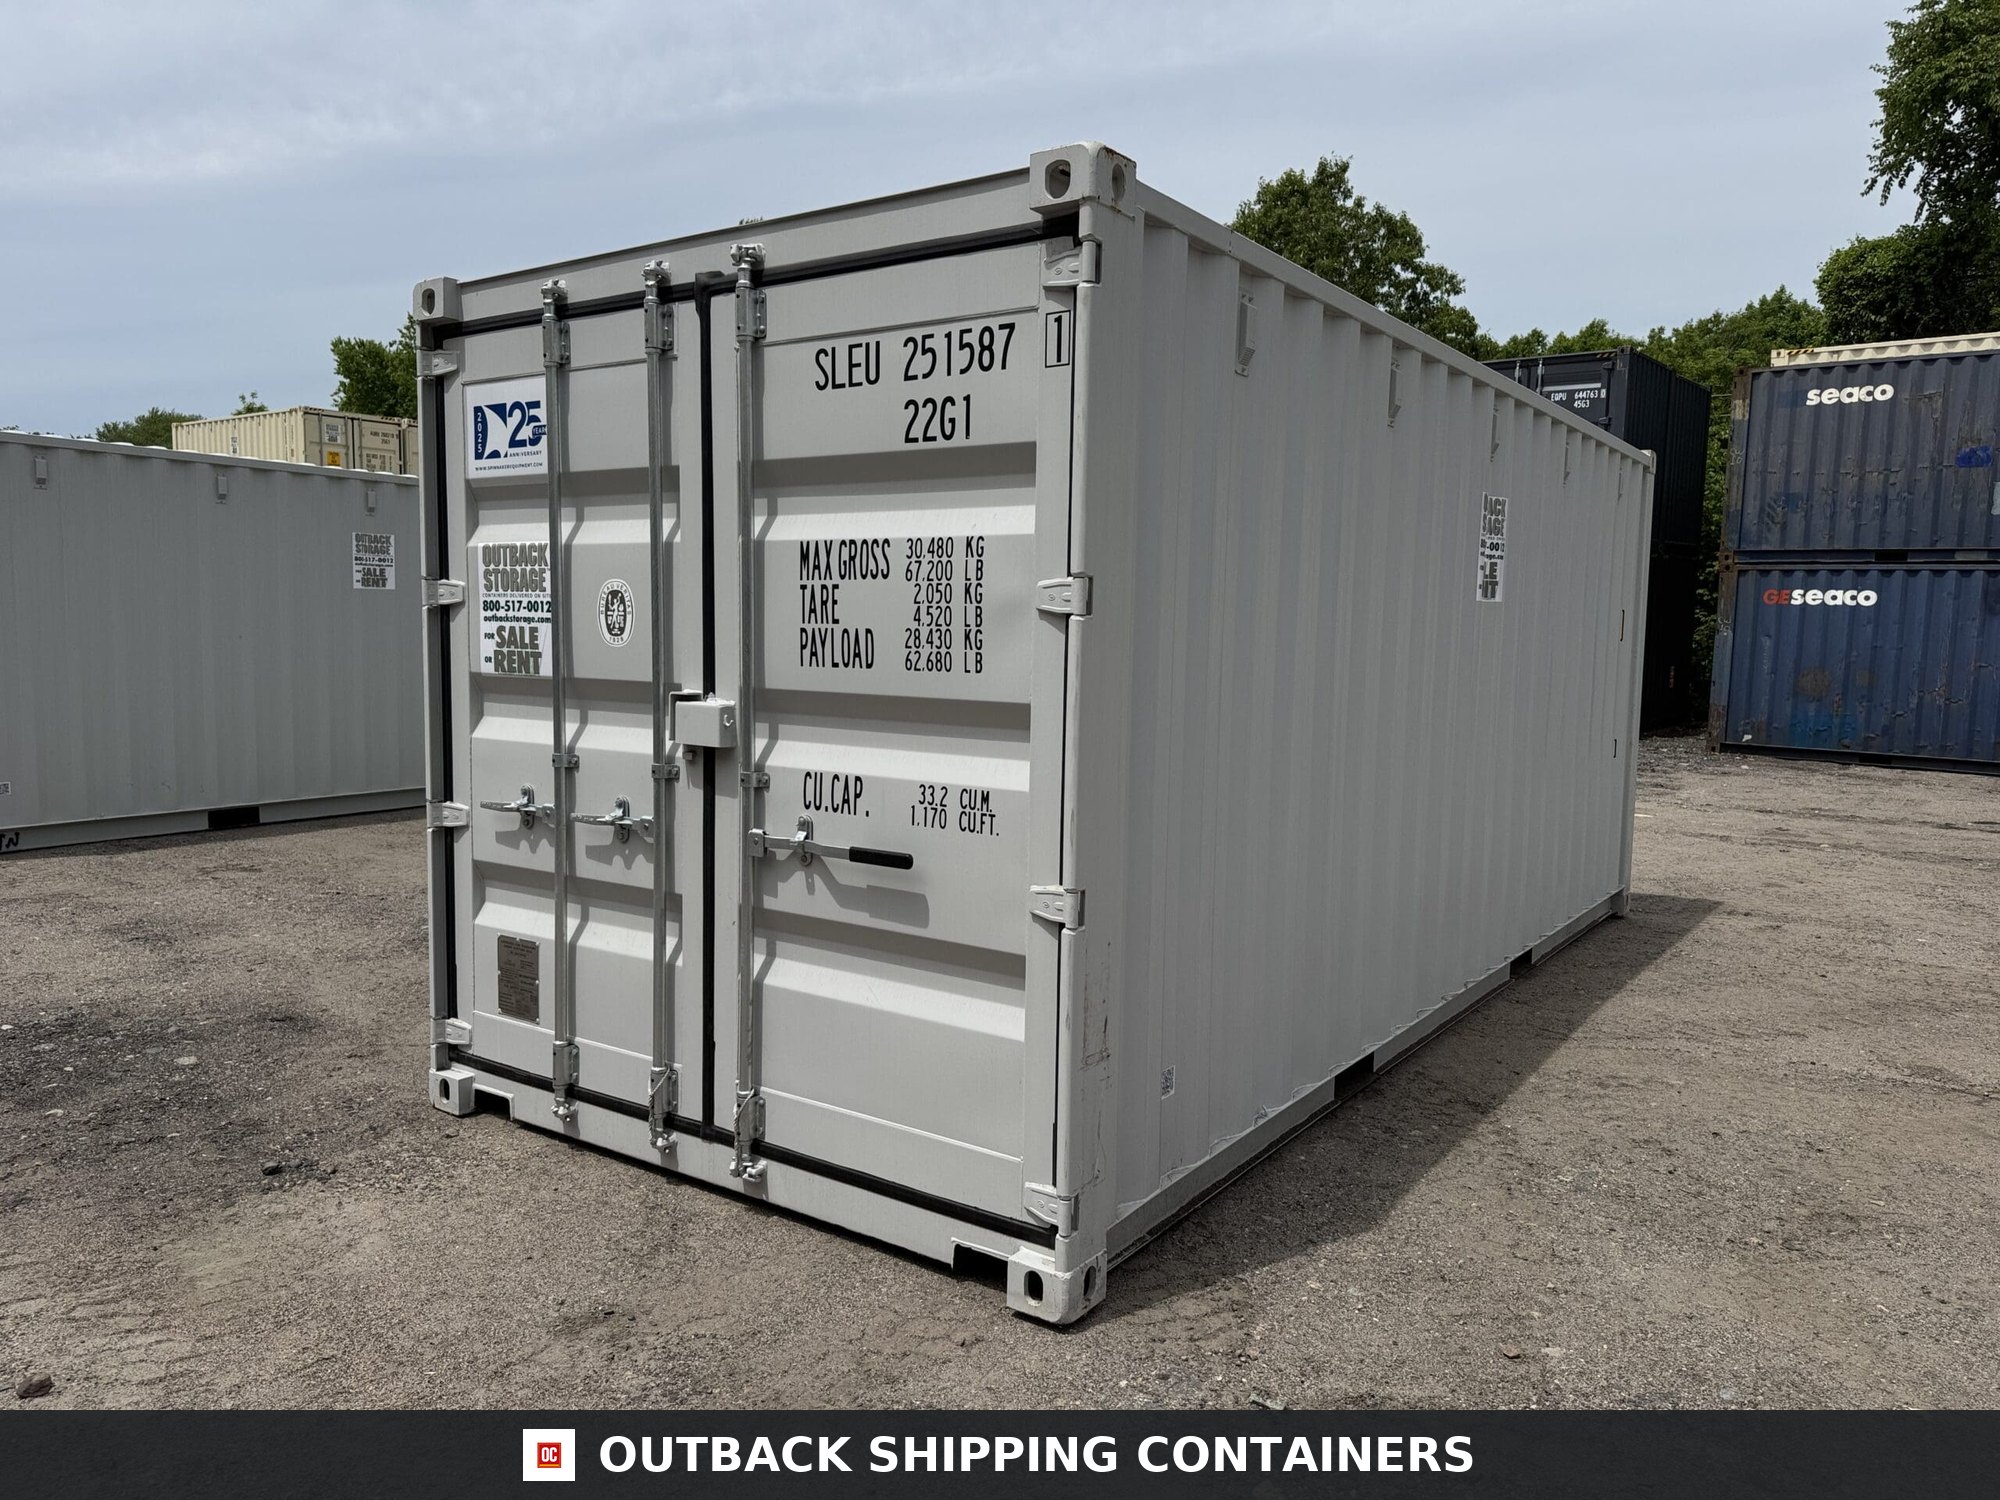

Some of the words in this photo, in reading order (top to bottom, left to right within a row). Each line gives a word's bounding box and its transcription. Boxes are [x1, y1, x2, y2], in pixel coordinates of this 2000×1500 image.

[814, 340, 881, 391] SLEU
[902, 322, 1016, 382] 251587
[1053, 314, 1063, 363] 1
[1805, 383, 1895, 407] seaco
[507, 400, 542, 448] 25
[903, 394, 971, 443] 22G1
[509, 450, 543, 458] ANNIVERSARY
[482, 542, 549, 567] OUTBACK
[799, 539, 833, 581] MAX
[838, 538, 891, 580] GROSS
[906, 537, 954, 559] 30,480
[965, 536, 985, 558] KG
[483, 567, 547, 592] STORAGE
[905, 560, 953, 582] 67,200
[965, 559, 984, 581] LB
[482, 600, 552, 613] 800-517-0012
[799, 584, 840, 625] TARE
[913, 582, 953, 605] 2,050
[964, 582, 984, 604] KG
[913, 605, 953, 627] 4,520
[964, 605, 983, 627] LB
[483, 613, 552, 625] outbackstorage.com
[484, 632, 495, 640] FOR
[495, 625, 539, 650] SALE
[799, 628, 875, 669] PAYLOAD
[904, 628, 953, 650] 28,430
[964, 628, 984, 650] KG
[493, 649, 542, 675] RENT
[904, 651, 953, 672] 62,680
[964, 651, 983, 673] LB
[918, 784, 948, 808] 33.2
[959, 788, 993, 813] CU.M.
[958, 811, 1000, 837] CU.FT.
